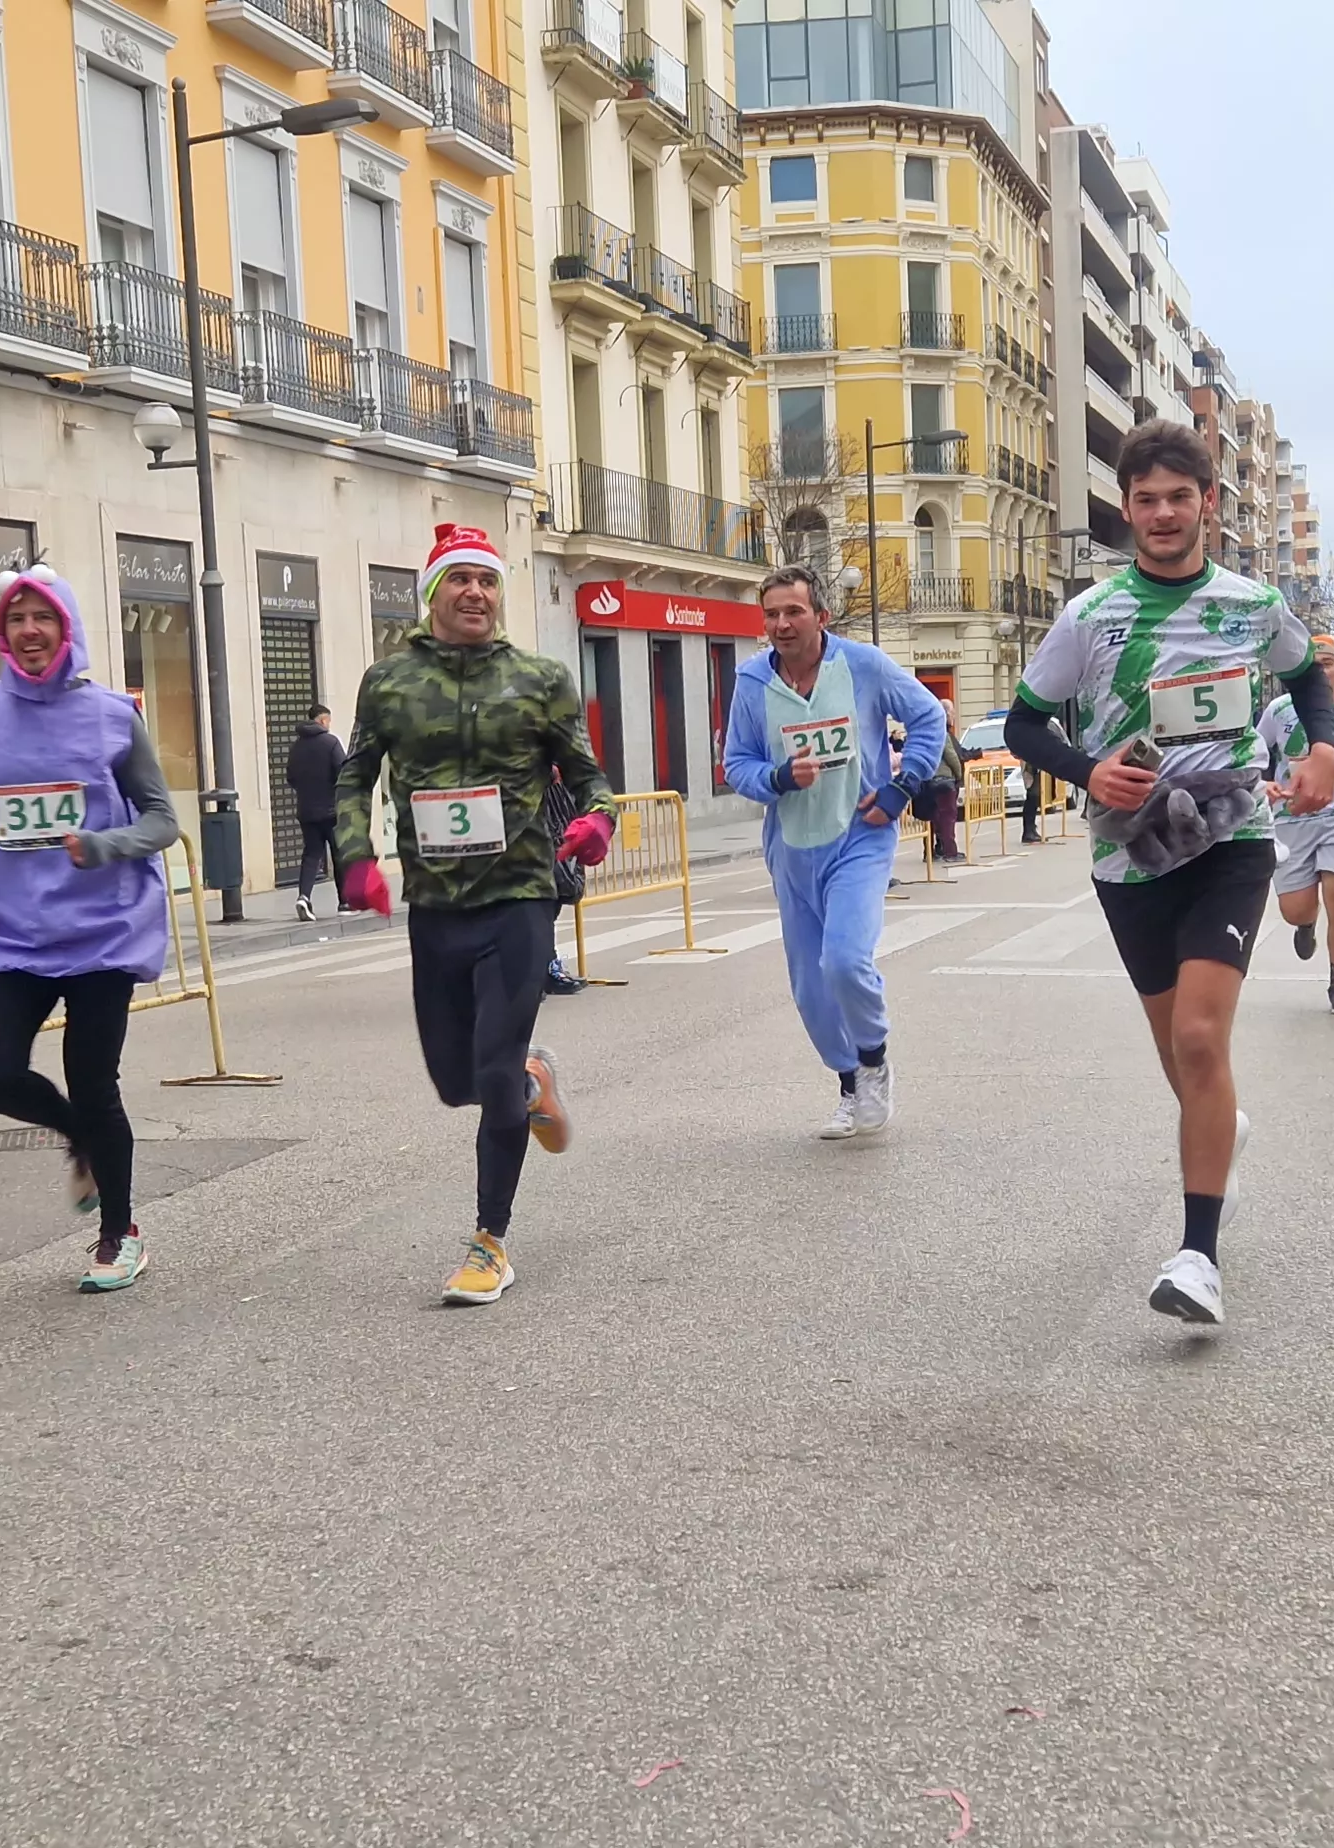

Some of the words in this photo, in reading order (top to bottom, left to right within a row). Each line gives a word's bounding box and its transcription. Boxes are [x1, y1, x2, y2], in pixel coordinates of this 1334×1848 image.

[118, 553, 150, 580] Pilar
[675, 604, 706, 627] Santander
[1193, 685, 1218, 723] 5
[793, 727, 850, 756] 312
[6, 794, 79, 831] 314
[448, 802, 470, 835] 3
